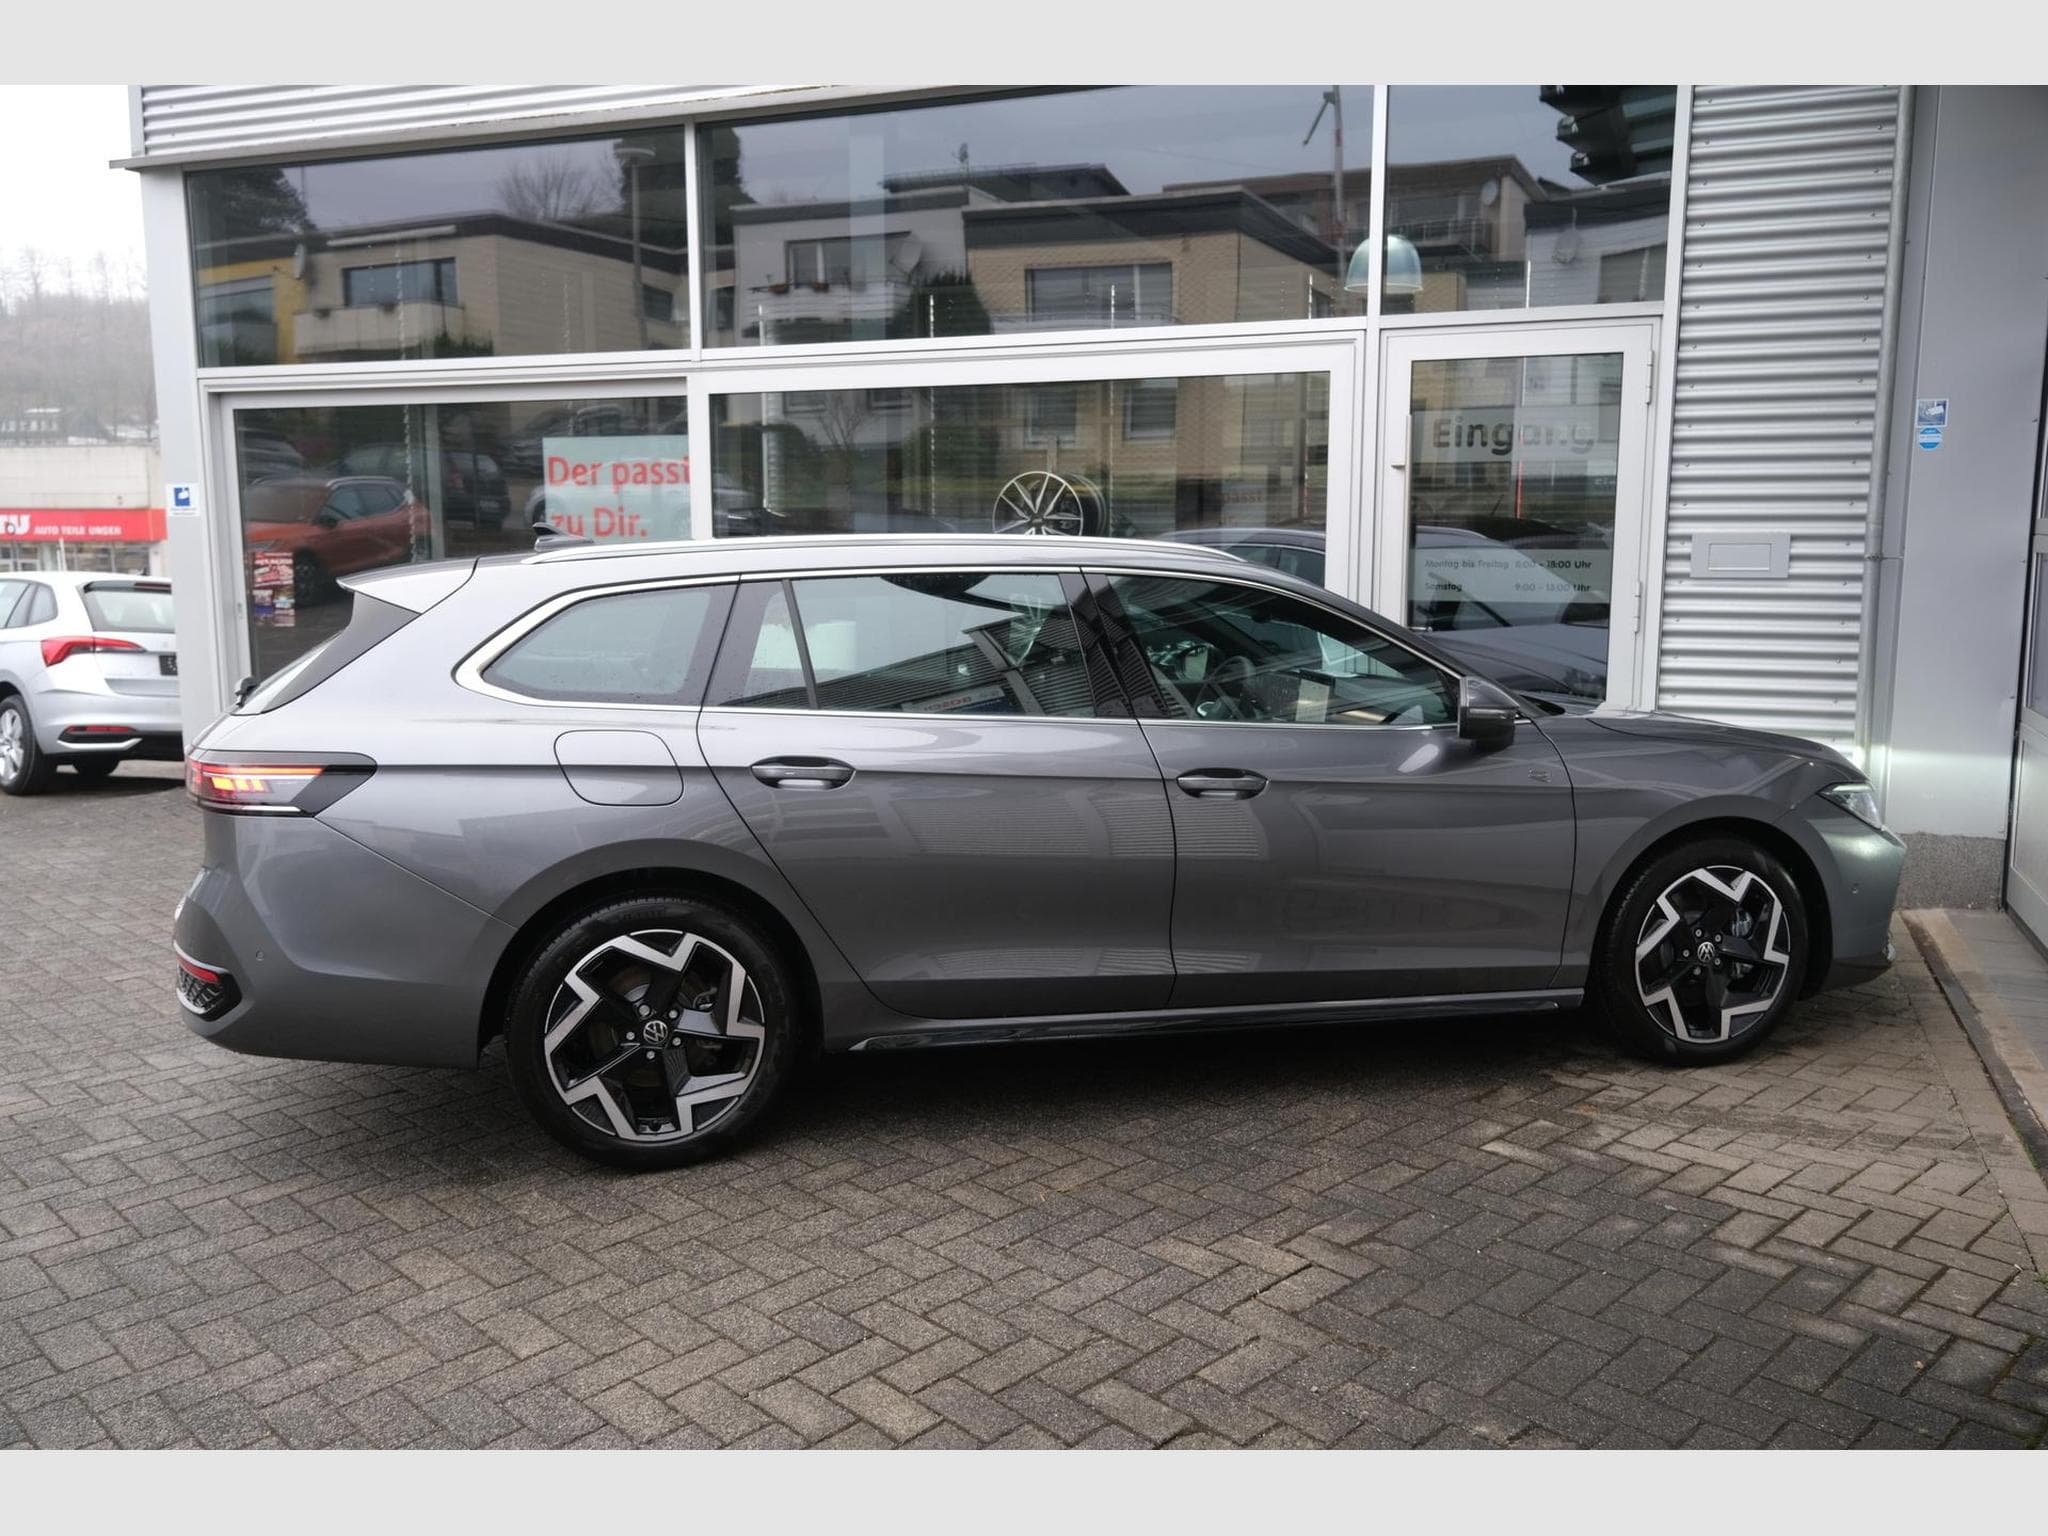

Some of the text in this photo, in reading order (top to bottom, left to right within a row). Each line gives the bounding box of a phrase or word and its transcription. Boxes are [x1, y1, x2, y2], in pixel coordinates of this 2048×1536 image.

[548, 456, 602, 485] Der
[593, 505, 648, 537] Dir.
[1574, 560, 1592, 569] Uhr
